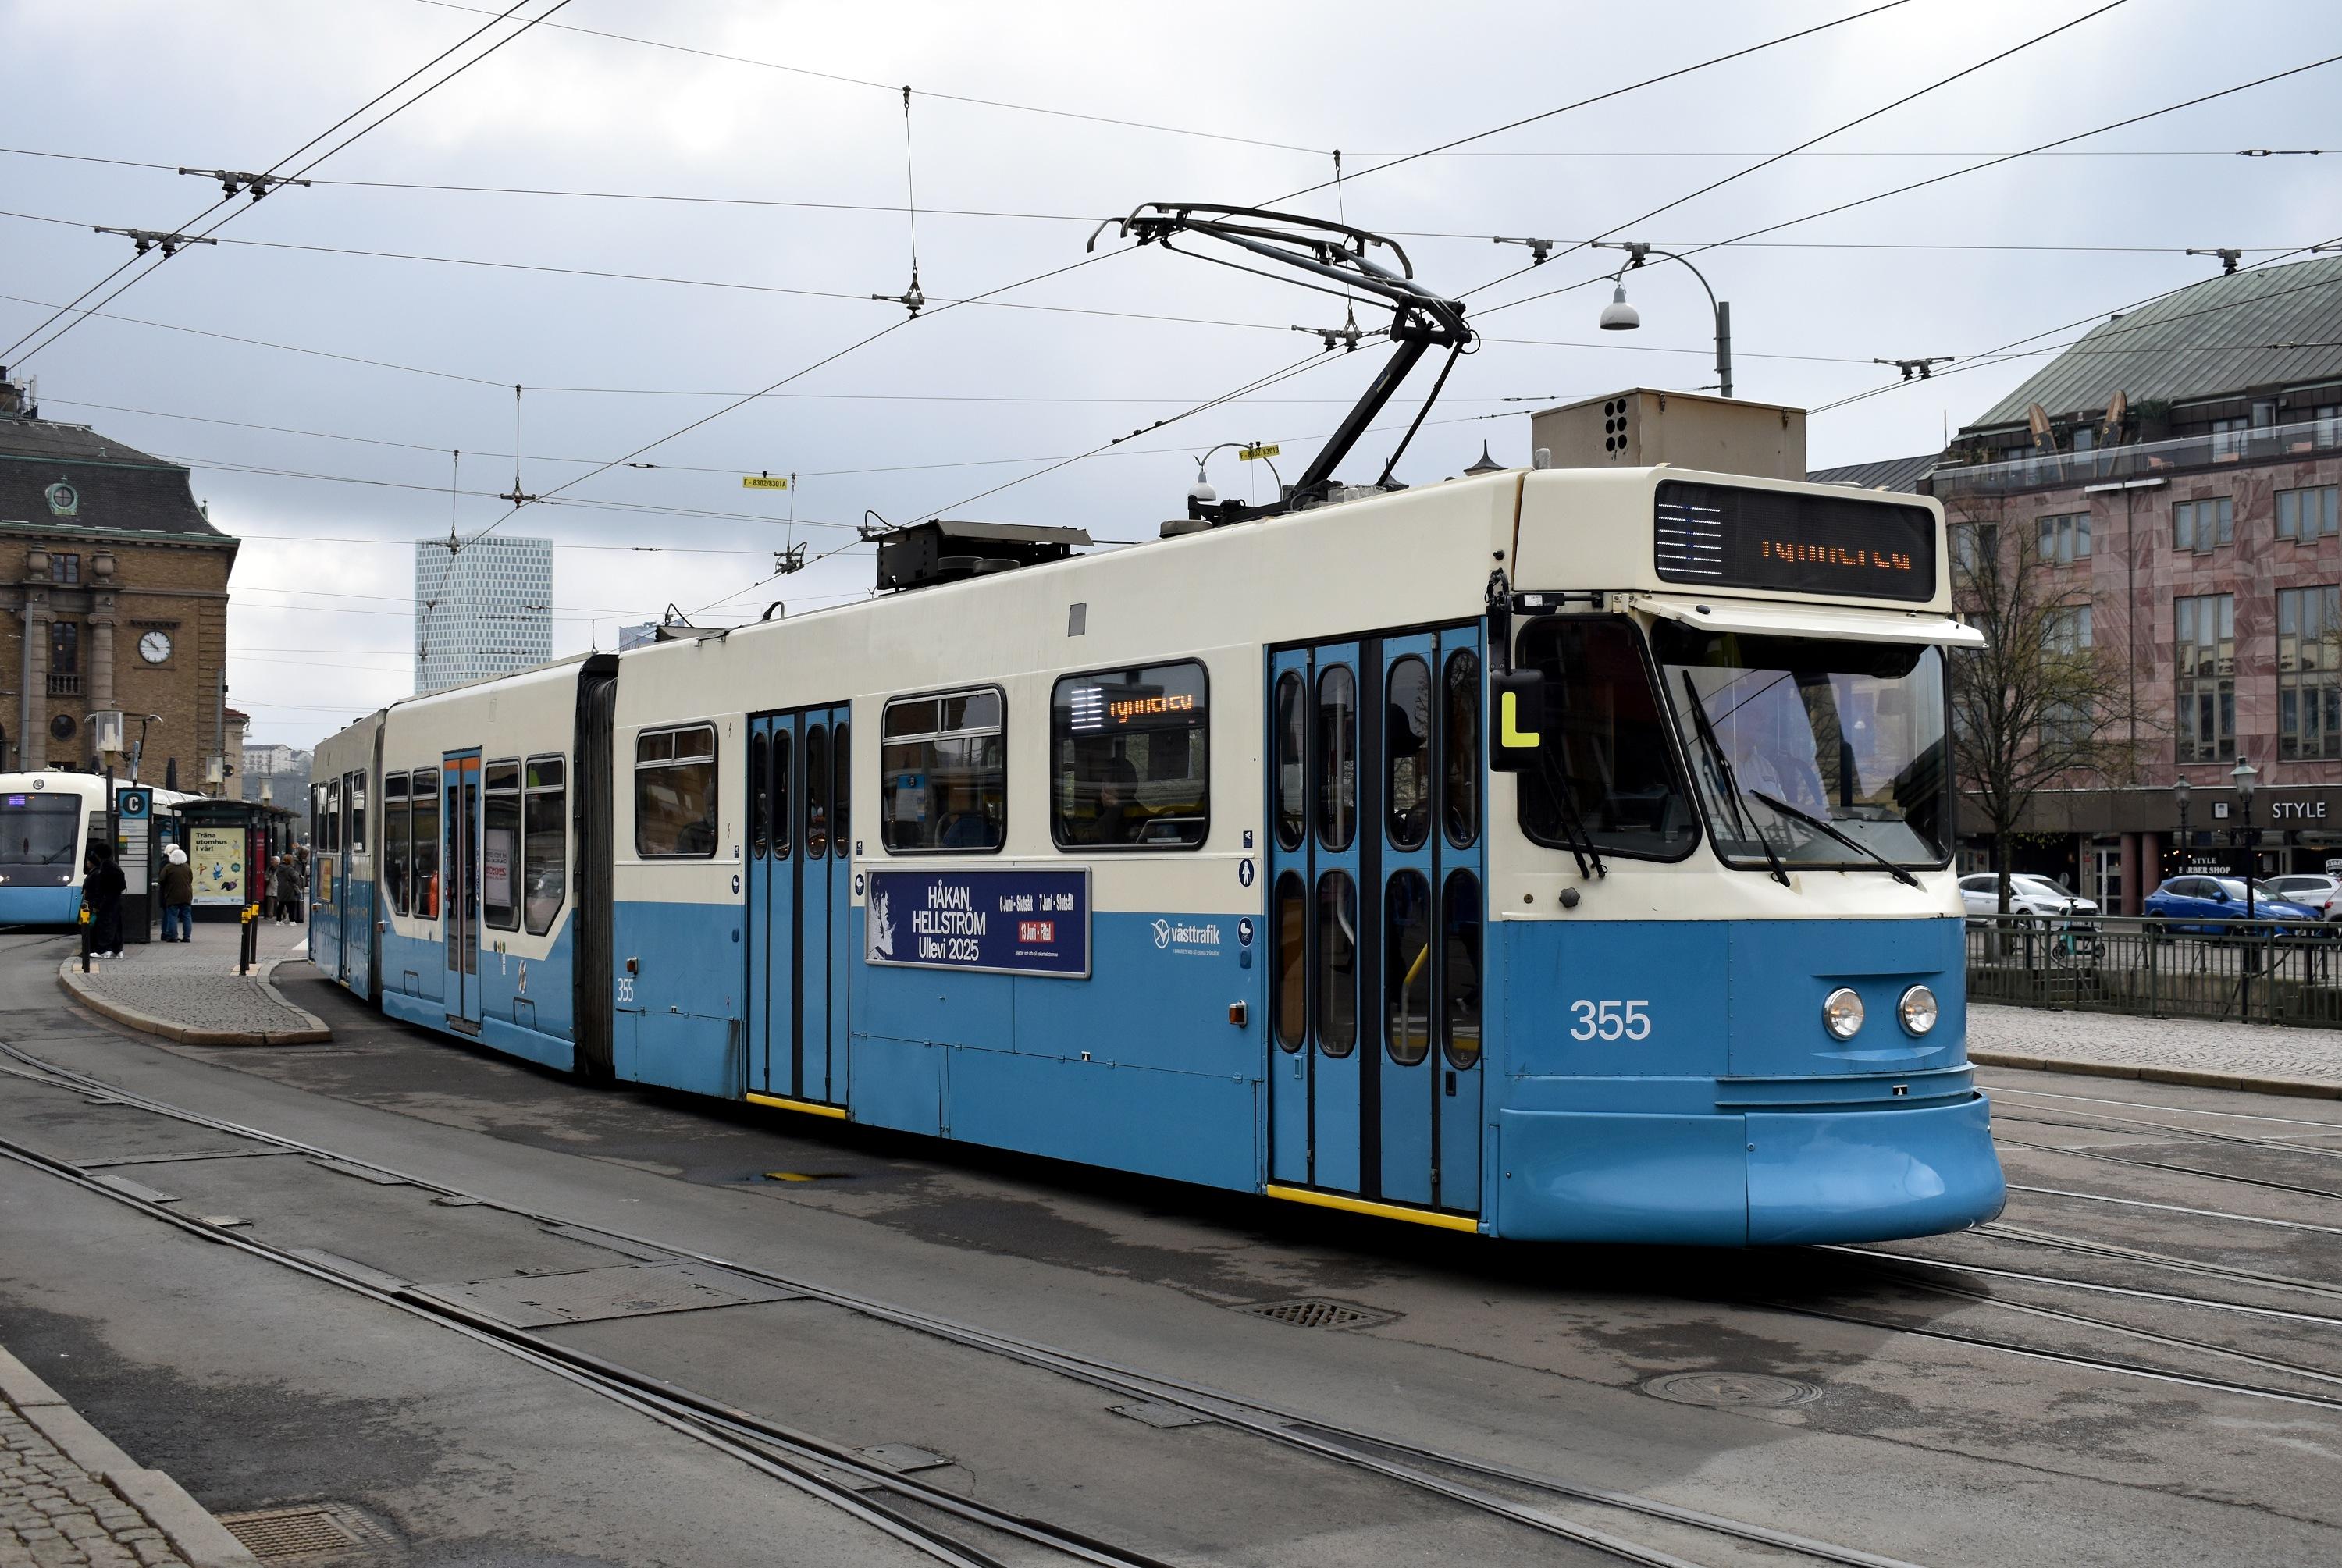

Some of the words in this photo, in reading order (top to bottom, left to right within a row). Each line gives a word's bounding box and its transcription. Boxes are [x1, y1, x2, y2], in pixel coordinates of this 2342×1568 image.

[129, 796, 139, 811] C
[2272, 802, 2326, 819] STYLE
[928, 879, 970, 911] HÅKAN
[999, 895, 1003, 912] 6
[1039, 894, 1043, 911] 7
[913, 906, 986, 936] HELLSTRÖM
[1172, 923, 1220, 944] västtrafik
[919, 937, 946, 959] Ullevi
[948, 938, 980, 961] 2025
[618, 977, 634, 1002] 355
[1570, 999, 1651, 1040] 355
